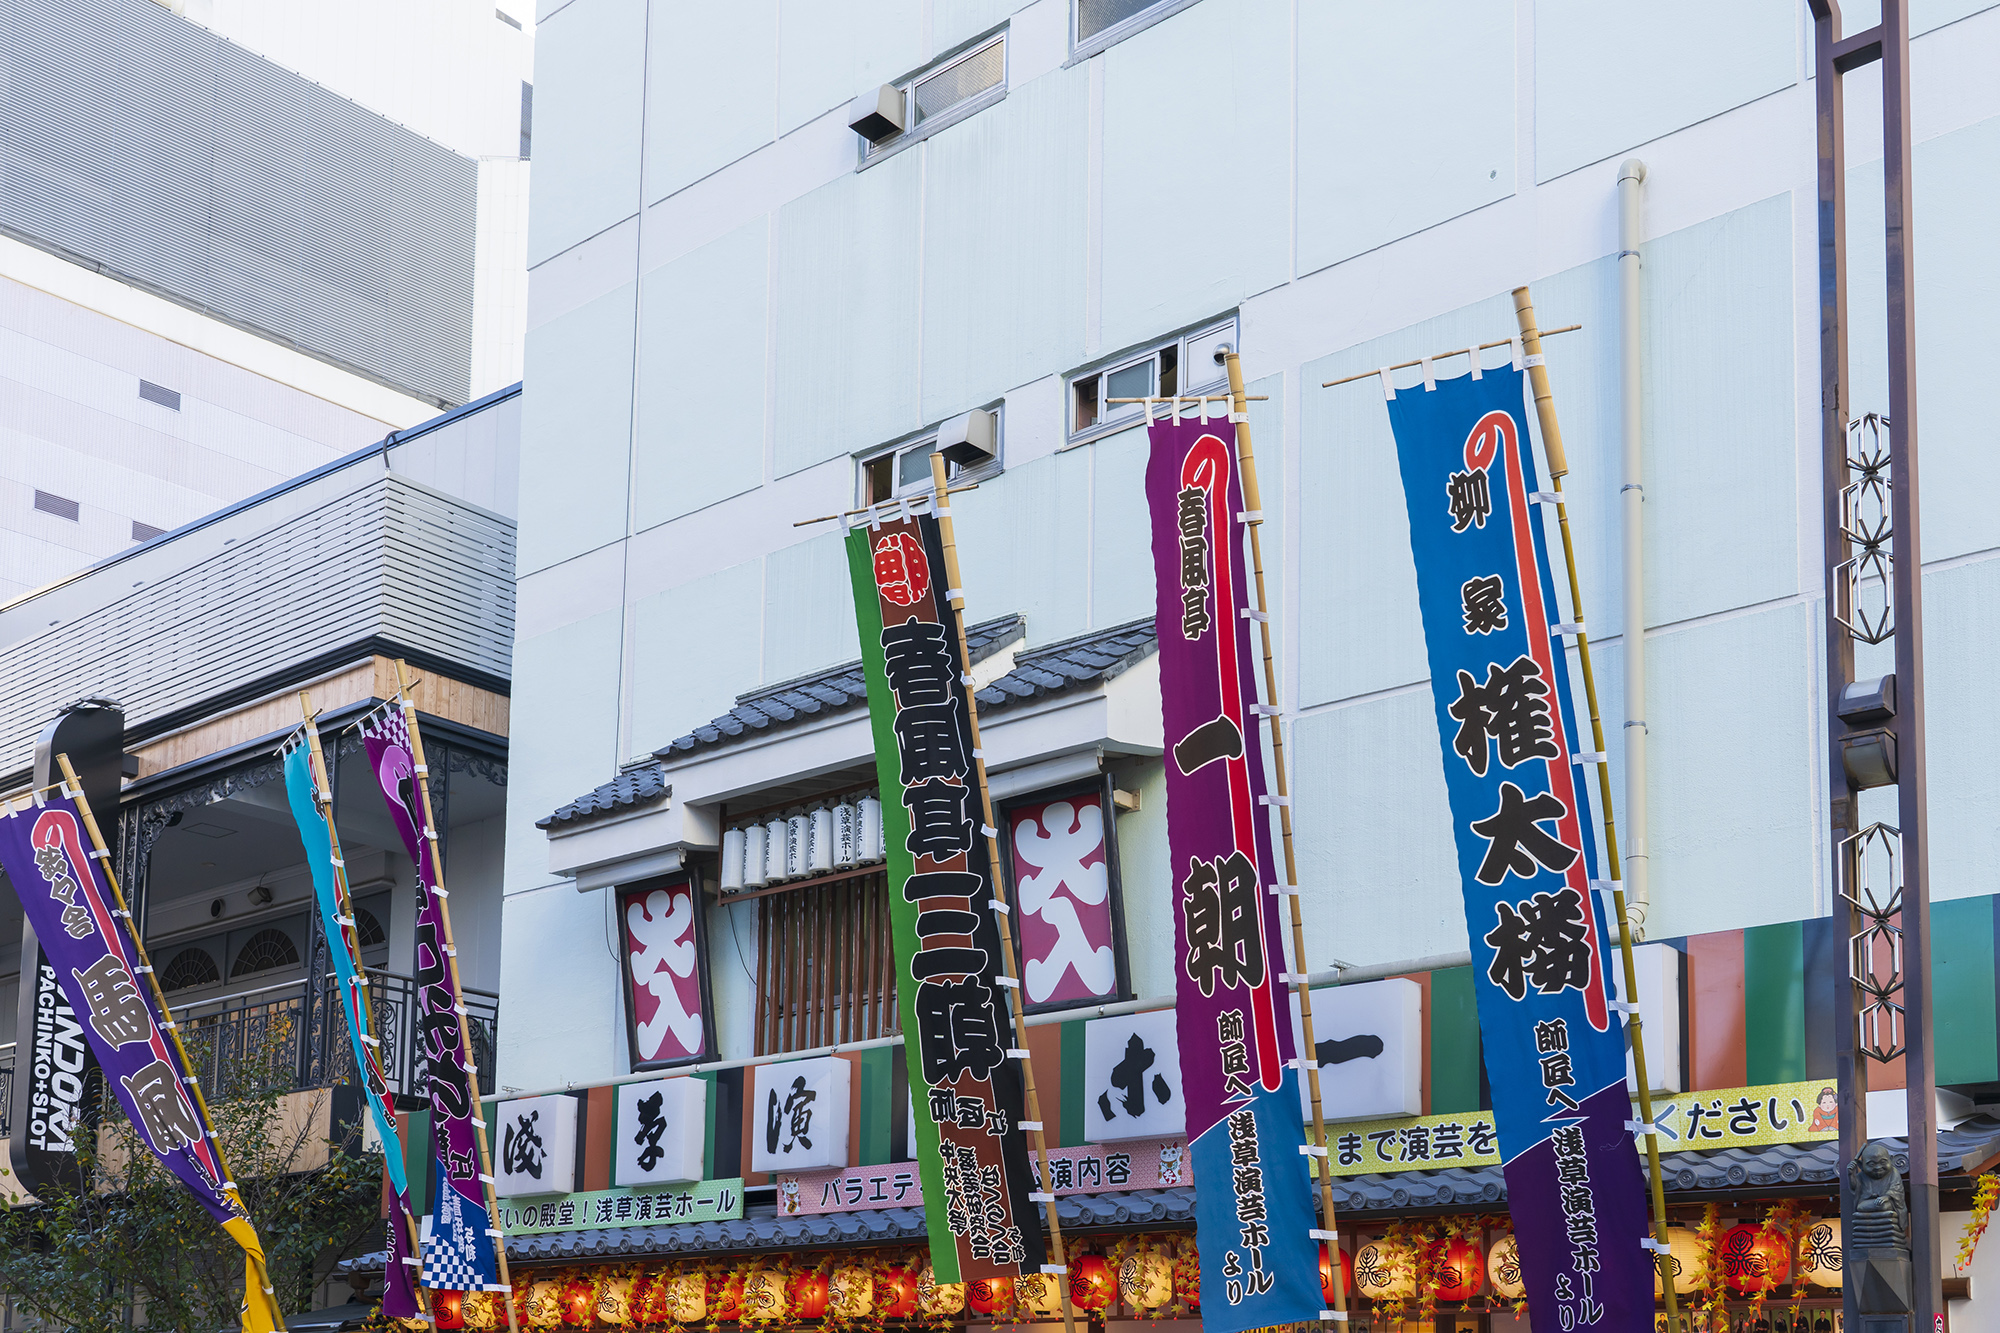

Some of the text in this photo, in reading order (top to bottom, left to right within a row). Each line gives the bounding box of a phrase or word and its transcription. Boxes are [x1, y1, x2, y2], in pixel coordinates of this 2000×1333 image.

[1173, 484, 1266, 1096] 春風亭 一朝 師匠へ
[30, 965, 56, 1151] PACHINKO+SLOT
[47, 984, 85, 1152] ANDORA
[634, 1090, 667, 1172] 草
[766, 1075, 817, 1154] 演
[1097, 1032, 1171, 1122] ホ
[1533, 1017, 1580, 1111] 師匠へ
[1634, 1097, 1805, 1141] ください
[819, 1173, 925, 1207] バラエテ
[1222, 1110, 1274, 1306] 浅草演芸ホール より
[1551, 1126, 1605, 1332] 浅草演芸ホール より
